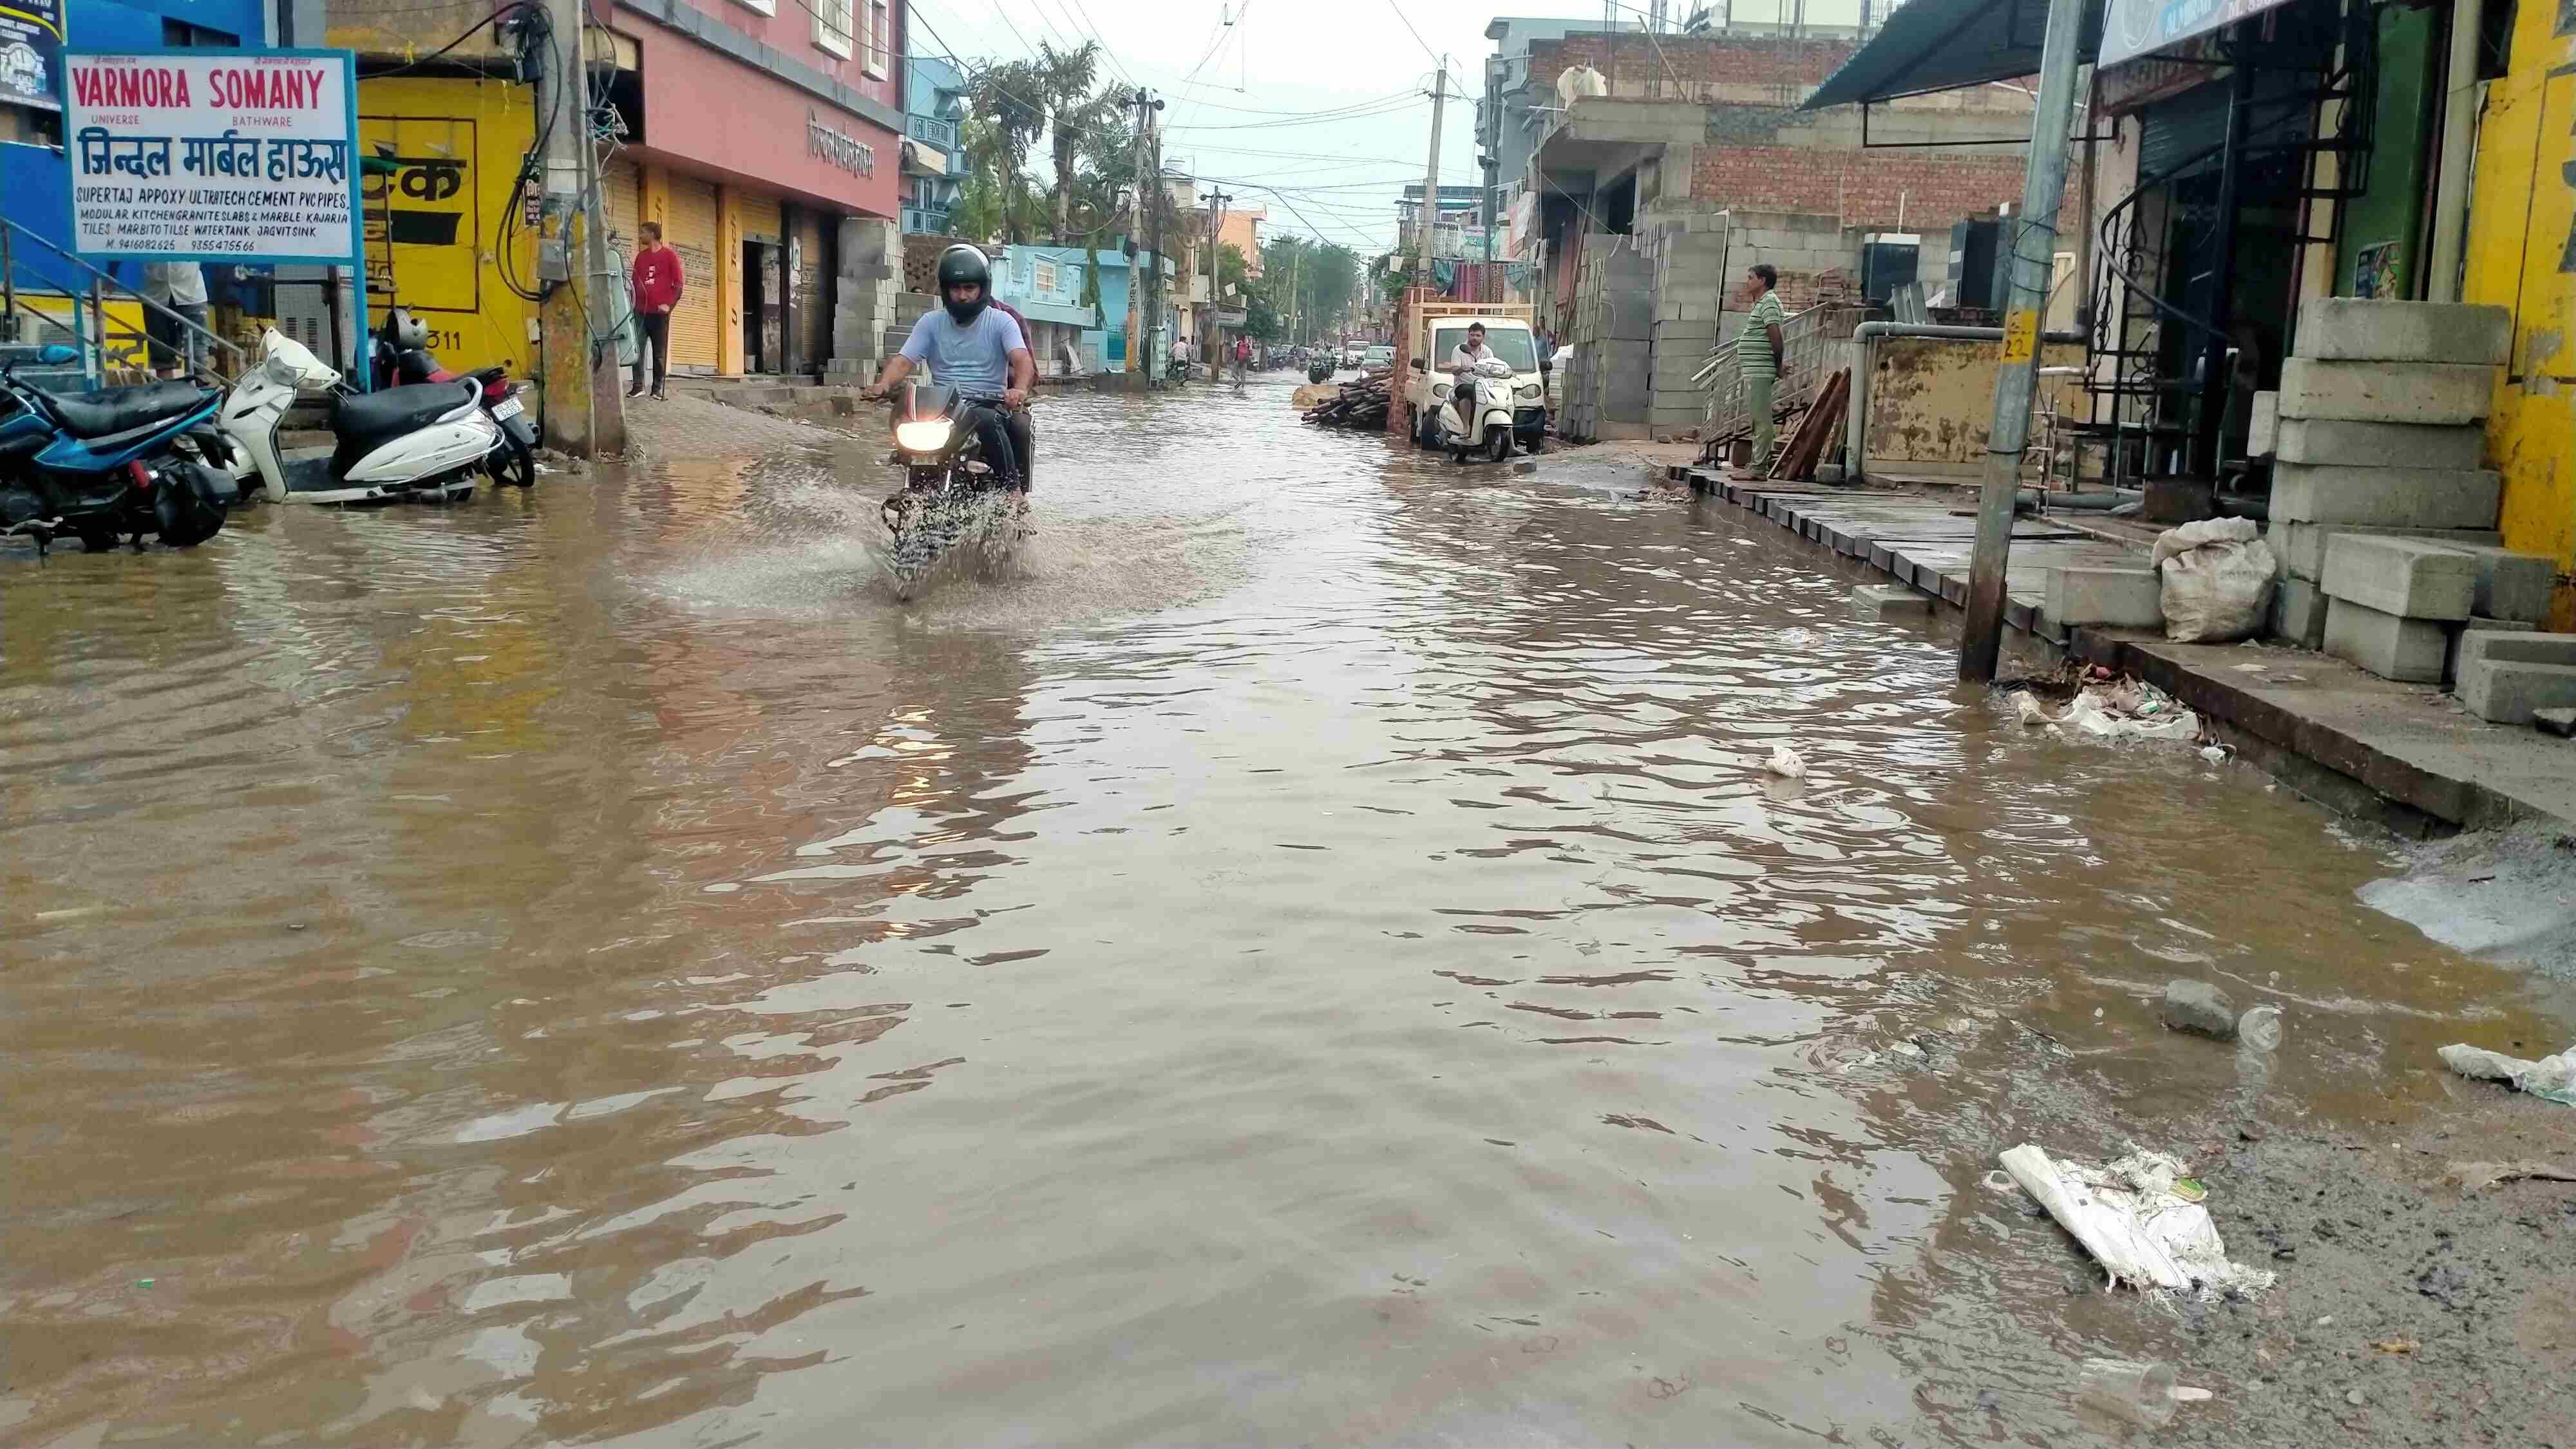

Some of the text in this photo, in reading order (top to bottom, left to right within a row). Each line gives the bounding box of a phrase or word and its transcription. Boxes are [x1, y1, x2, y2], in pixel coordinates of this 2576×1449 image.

[72, 68, 325, 109] VARMORA SOMANY
[91, 115, 292, 126] UNIVERSE BATHWARE
[77, 126, 346, 185] जिन्दल मार्बल हाऊस
[76, 187, 133, 204] SUPERTAJ
[139, 187, 185, 205] APPOXY
[248, 191, 296, 206] CEMENT
[299, 191, 316, 207] PVC
[80, 209, 129, 220] MODULAR
[261, 211, 301, 222] MARBLE
[307, 213, 348, 223] KAJARIA
[82, 223, 110, 234] TILES
[117, 223, 161, 235] MARBITO
[164, 223, 189, 236] TILSE
[118, 240, 175, 250] 9416082625
[191, 240, 254, 251] 9355475566
